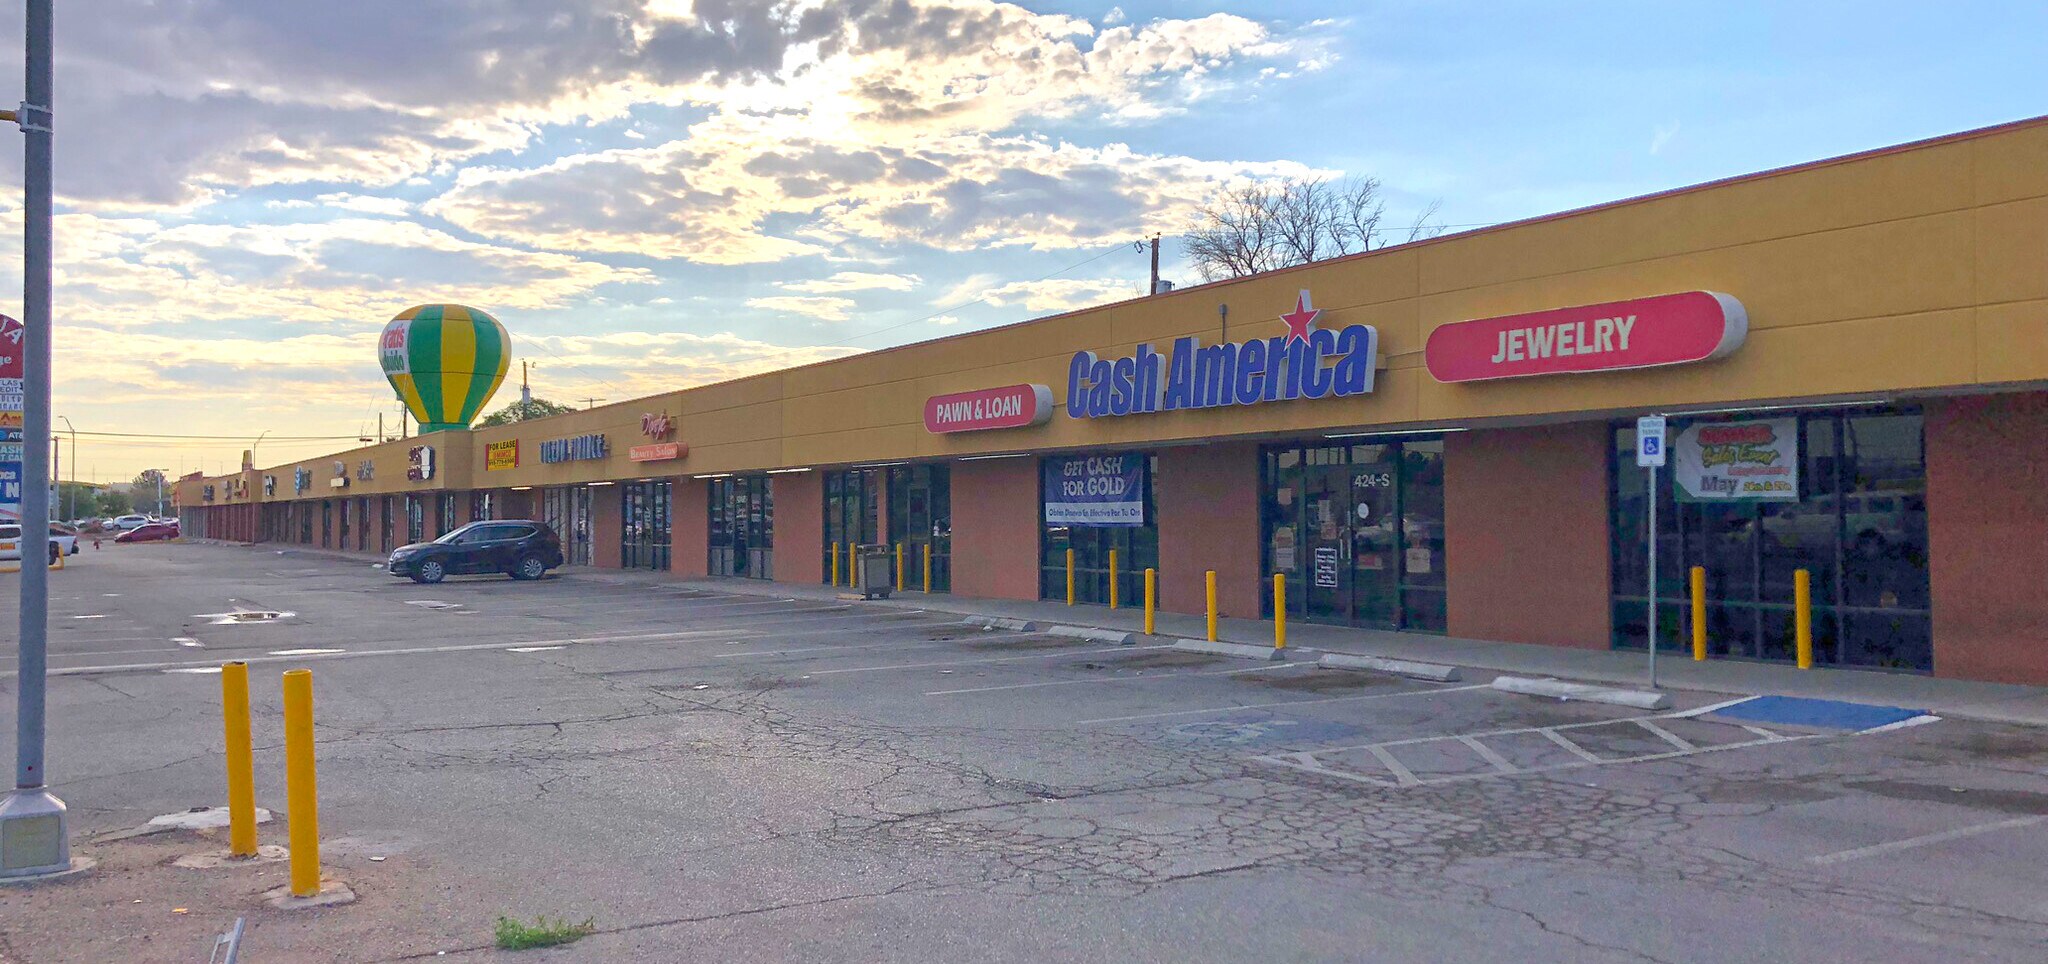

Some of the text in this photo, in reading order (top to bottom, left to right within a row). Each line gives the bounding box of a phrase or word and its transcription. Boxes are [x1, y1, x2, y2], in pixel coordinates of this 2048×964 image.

[1492, 315, 1637, 364] JEWELRY
[1066, 324, 1380, 420] Cash America
[936, 394, 1022, 424] PAWN & LOAN
[489, 439, 516, 451] FOR LEASE
[1063, 456, 1123, 477] GET CASH
[1063, 476, 1125, 496] FOR GOLD
[1354, 473, 1390, 488] 424-S
[1701, 475, 1739, 496] May
